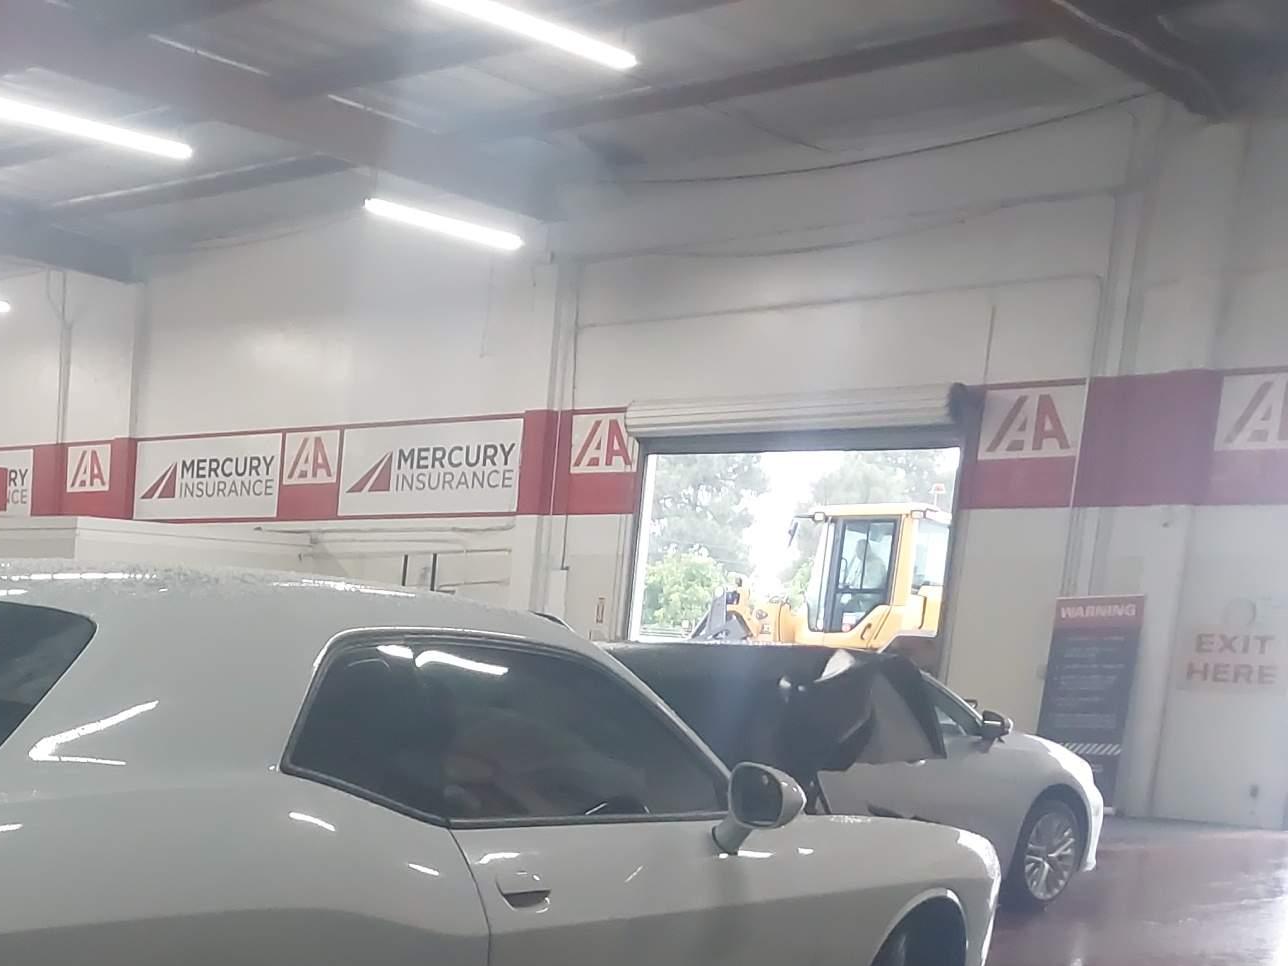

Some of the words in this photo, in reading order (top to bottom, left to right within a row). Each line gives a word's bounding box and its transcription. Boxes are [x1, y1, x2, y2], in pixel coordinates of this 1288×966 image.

[180, 455, 275, 479] MERCURY
[397, 443, 516, 470] MERCURY
[179, 479, 274, 500] INSURANCE
[395, 468, 514, 493] INSURANCE
[1060, 603, 1137, 619] WARNING
[1195, 633, 1275, 655] EXIT
[1186, 662, 1278, 685] HERE
